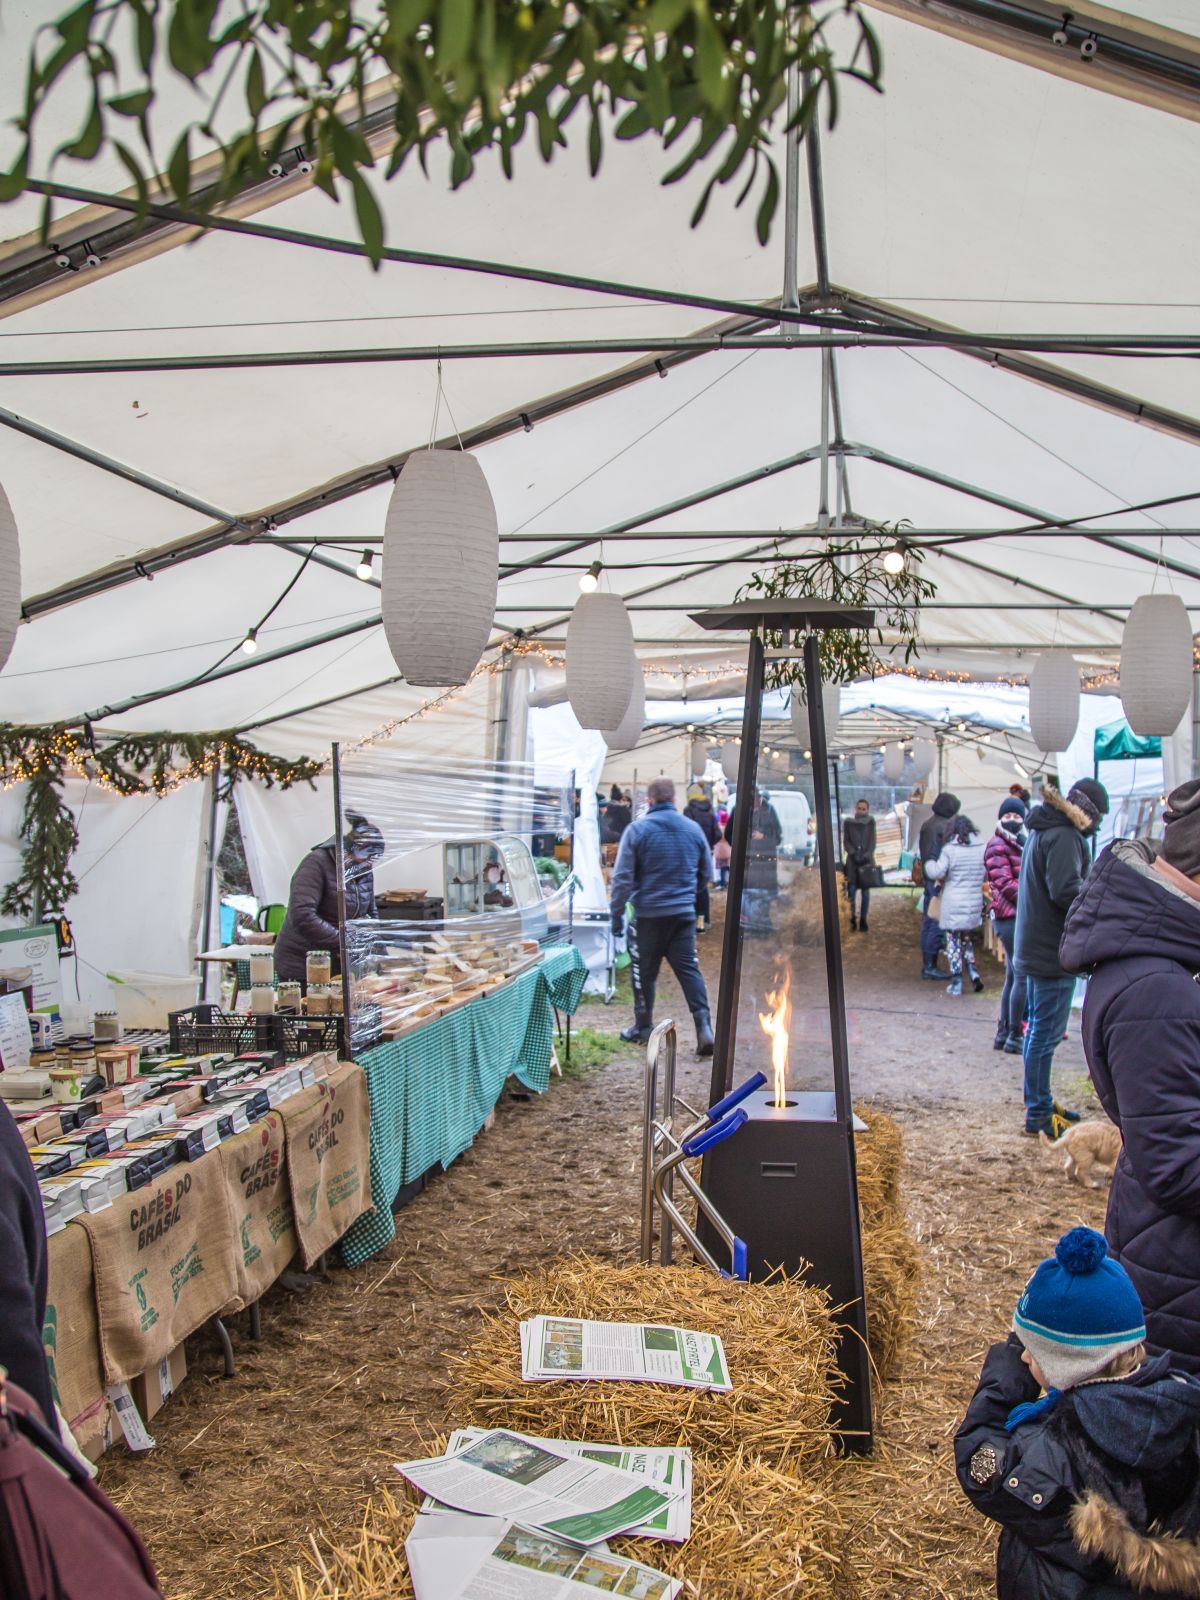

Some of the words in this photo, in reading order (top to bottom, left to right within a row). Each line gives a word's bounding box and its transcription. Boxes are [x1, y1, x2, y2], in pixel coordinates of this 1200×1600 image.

[331, 1108, 344, 1129] DO
[130, 1188, 174, 1231] CAFÉS
[175, 1172, 192, 1204] DO
[138, 1203, 181, 1251] BRASIL
[632, 1453, 648, 1473] NASZ
